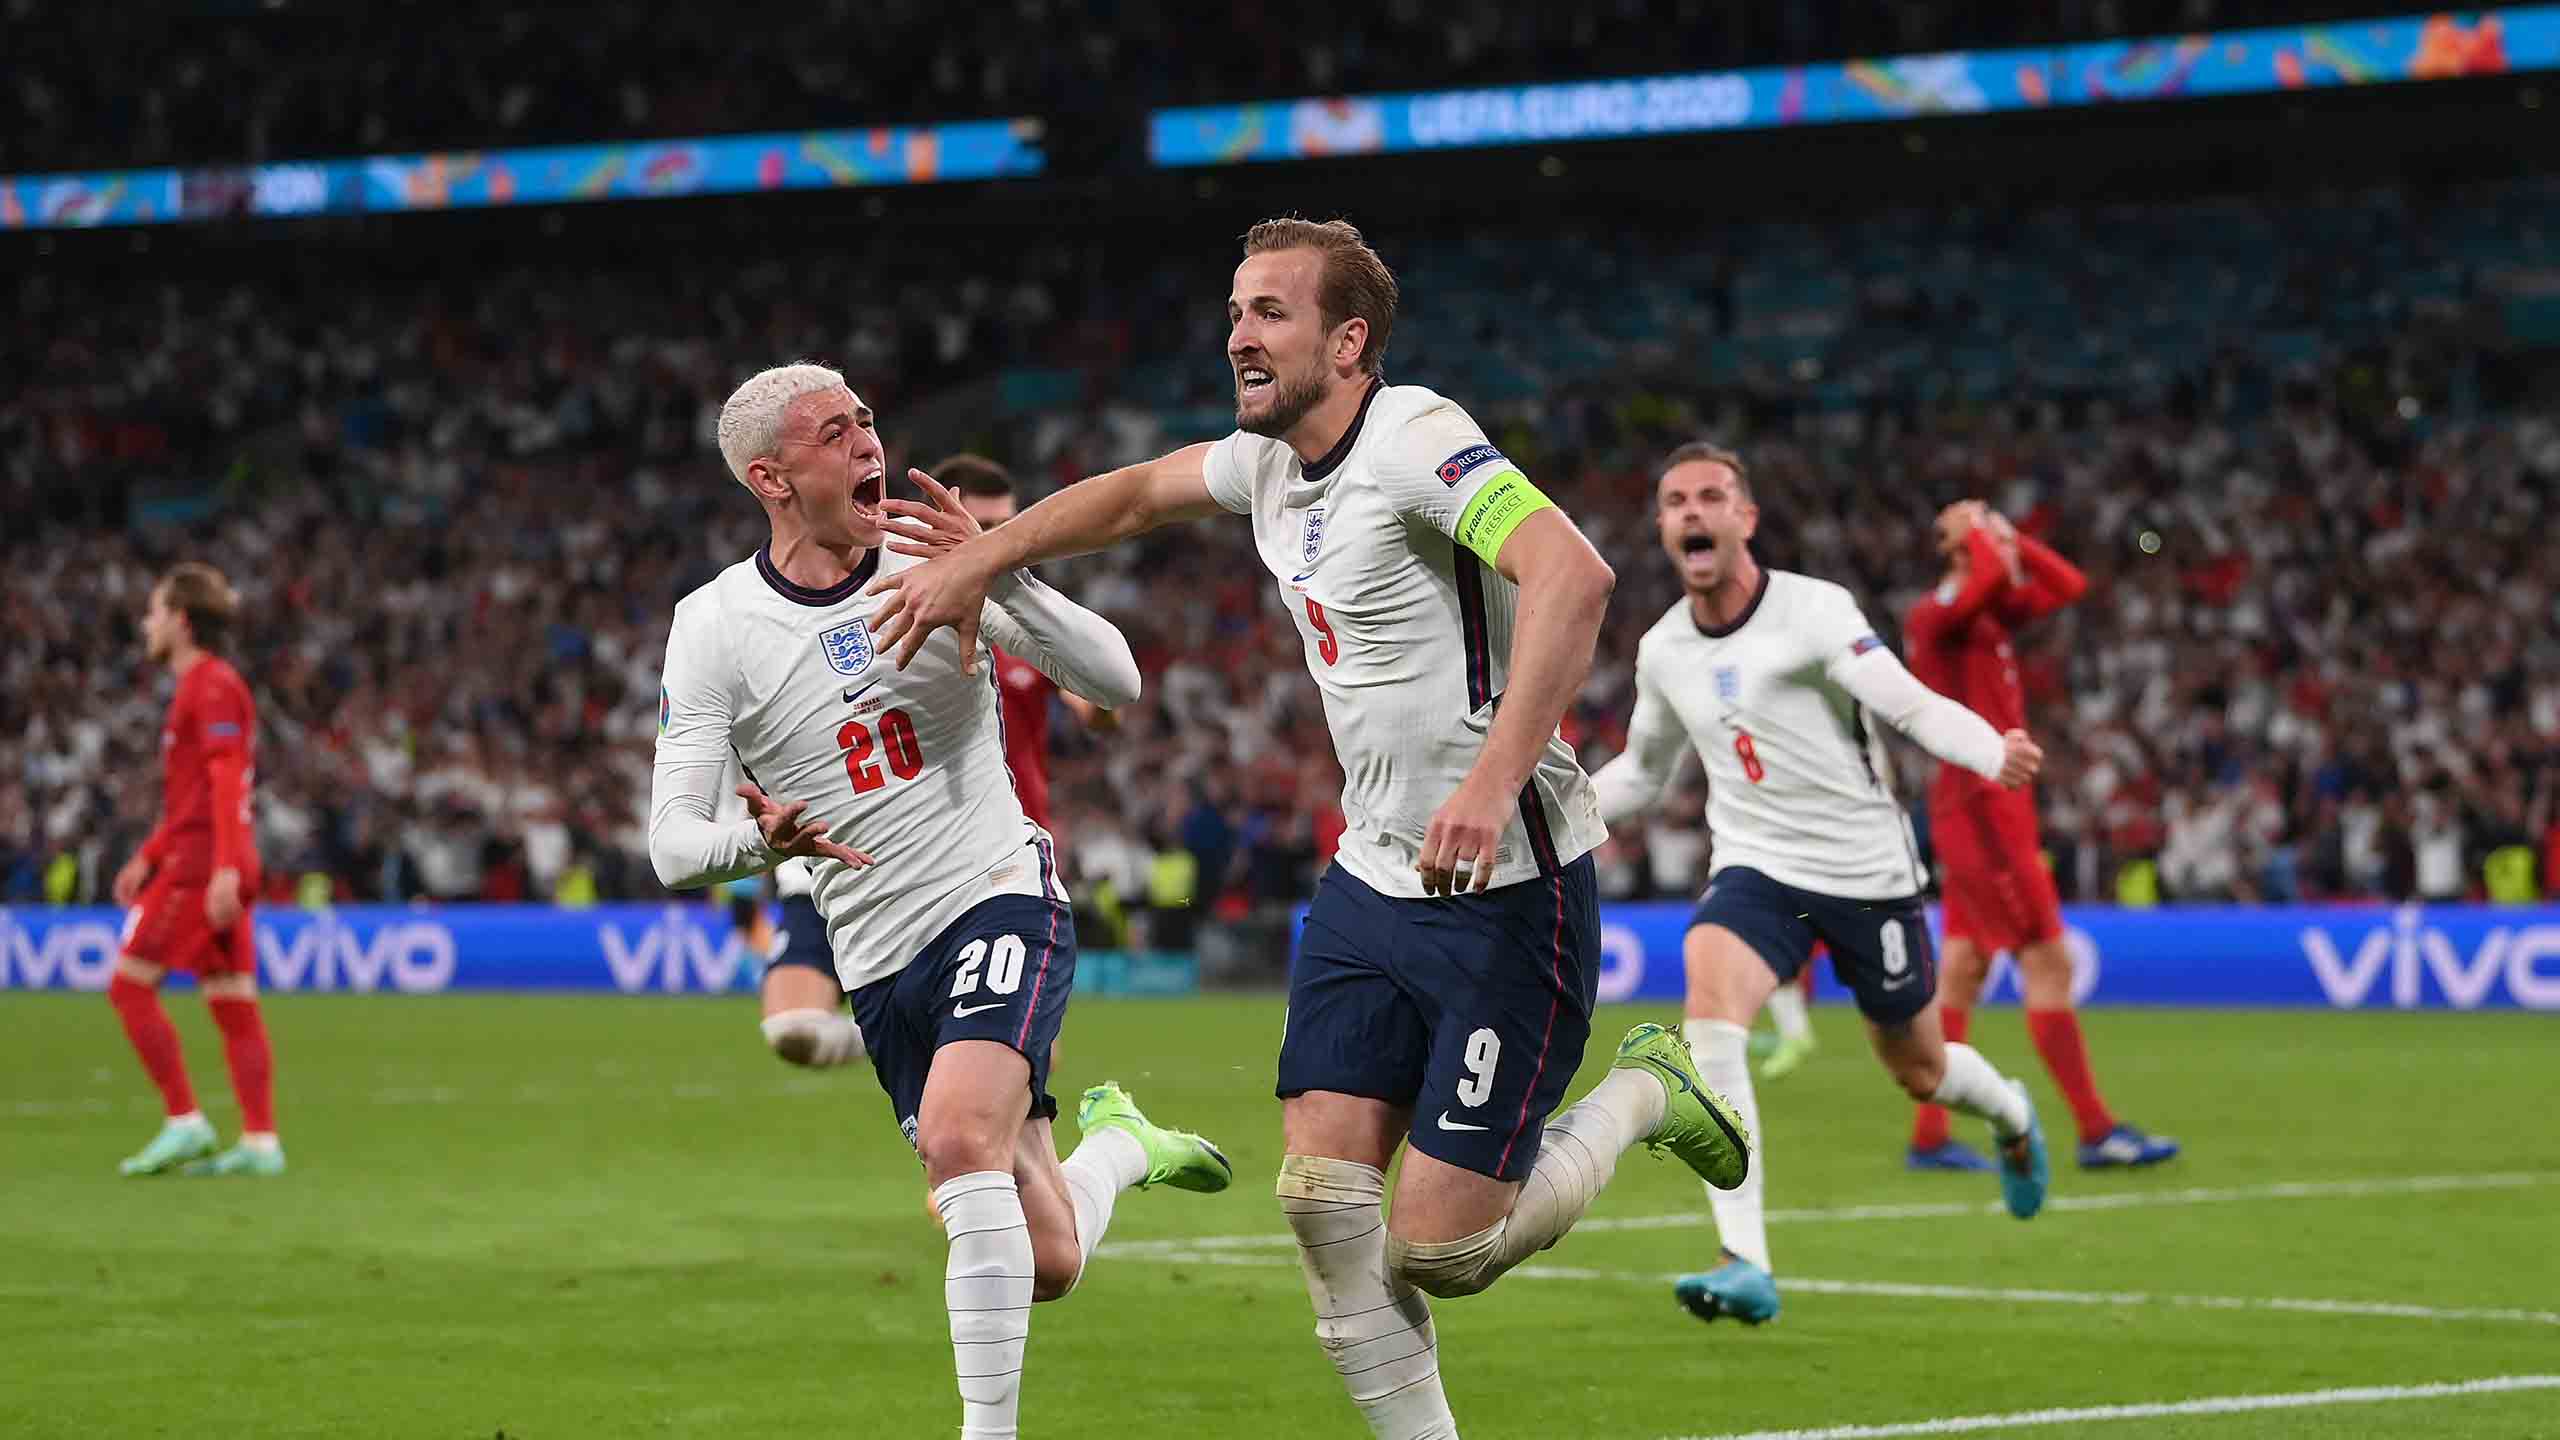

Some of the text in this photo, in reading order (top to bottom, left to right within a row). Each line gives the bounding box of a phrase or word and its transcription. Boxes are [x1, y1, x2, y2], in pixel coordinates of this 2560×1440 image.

[1409, 72, 1751, 147] UEFA EURO 2020
[1464, 482, 1516, 544] #EQUAL GAME
[1484, 494, 1522, 535] RESPECT
[1304, 596, 1339, 667] 9
[836, 708, 925, 795] 20
[1734, 734, 1764, 784] 8
[256, 907, 457, 992] vivo
[599, 905, 747, 993] viv
[949, 933, 1026, 999] 20
[1880, 918, 1907, 975] 8
[1457, 1027, 1501, 1108] 9
